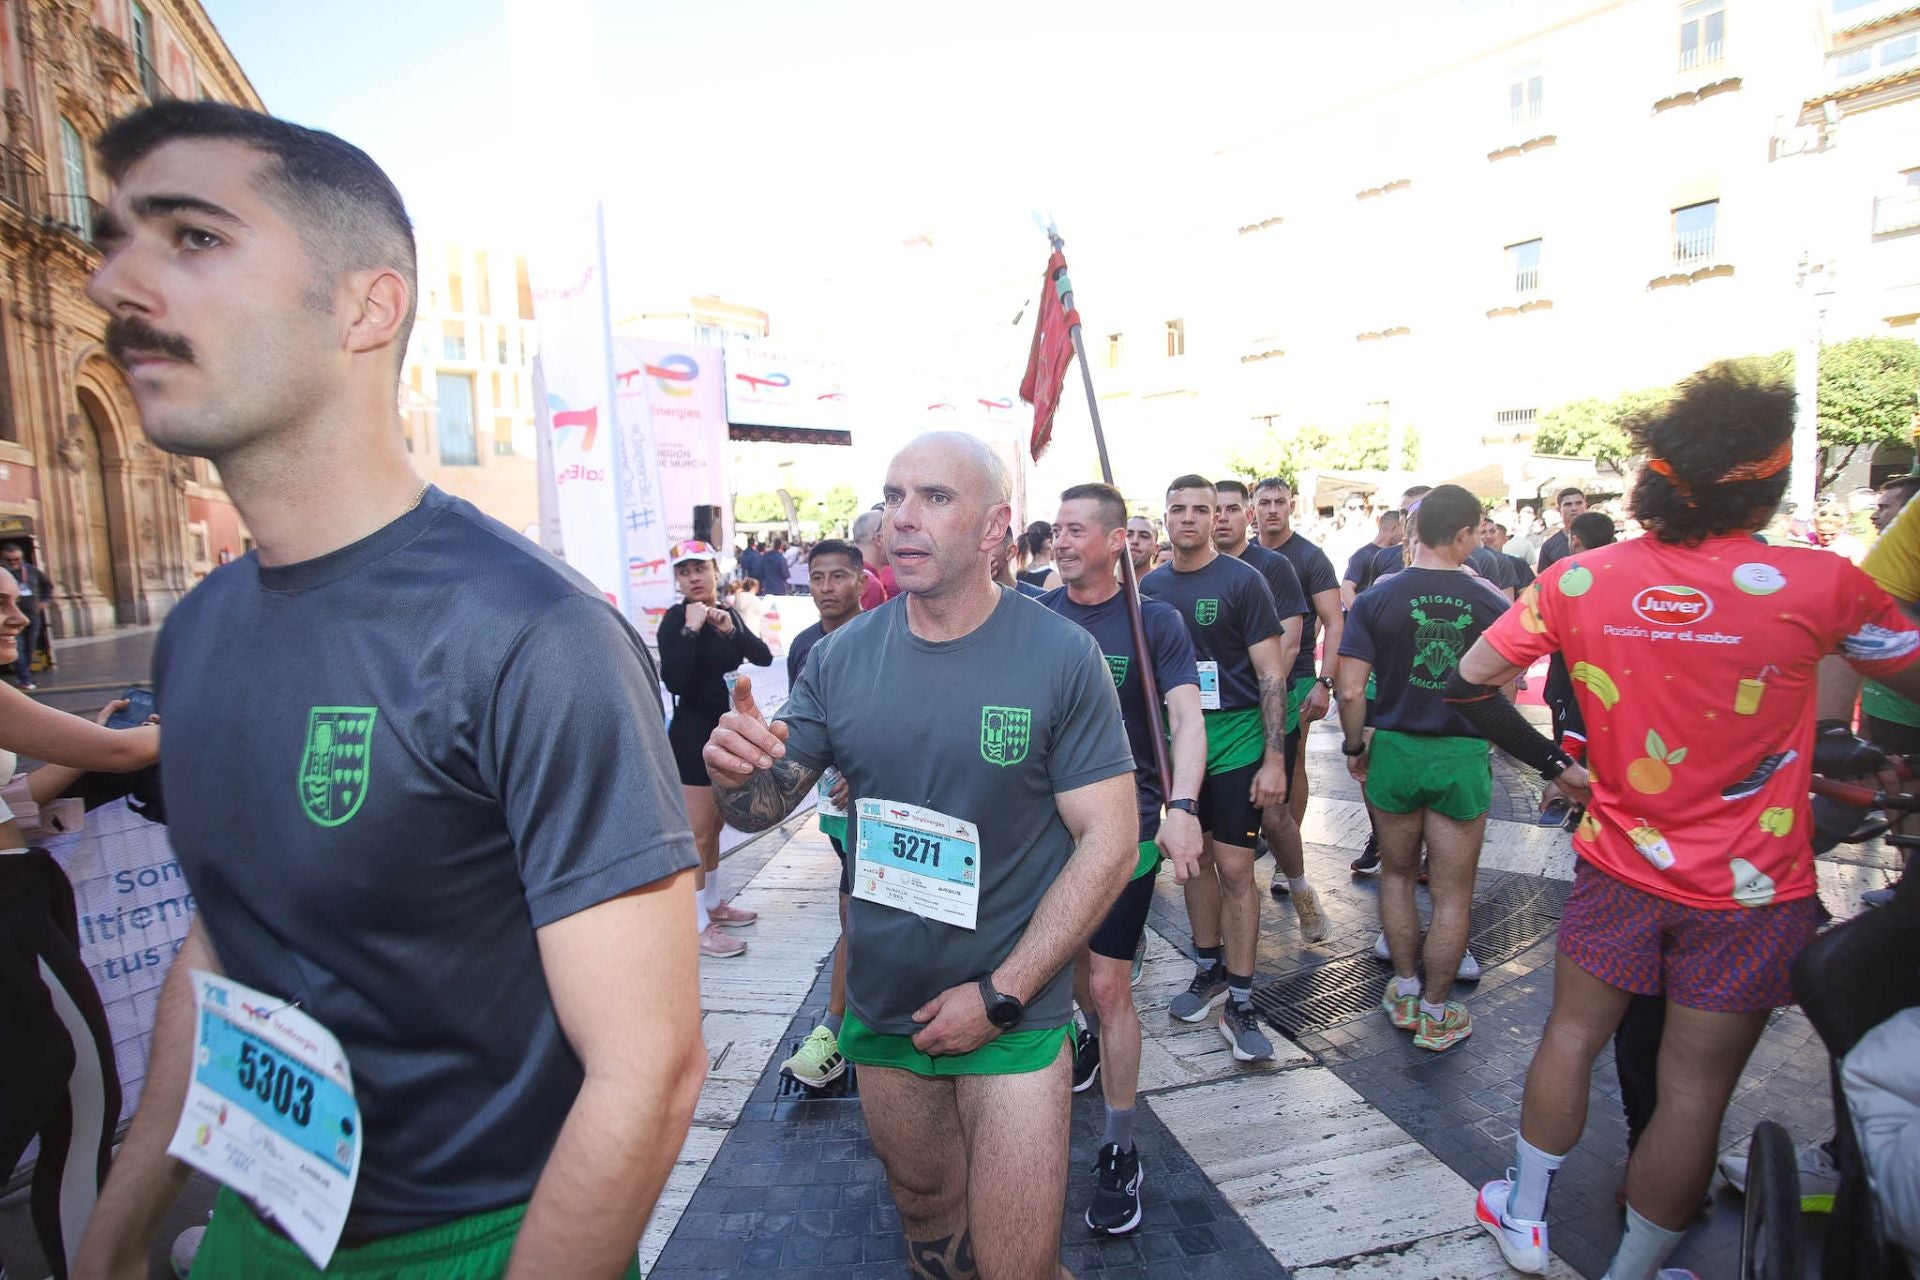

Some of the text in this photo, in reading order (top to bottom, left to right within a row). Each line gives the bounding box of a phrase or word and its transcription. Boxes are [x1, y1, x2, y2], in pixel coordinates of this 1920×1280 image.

[1410, 595, 1472, 612] BRIGADA
[1640, 597, 1704, 614] Juver
[1603, 624, 1744, 645] Pasión por el sabor
[892, 832, 941, 867] 5271
[104, 948, 160, 979] tus
[238, 1040, 316, 1127] 5303
